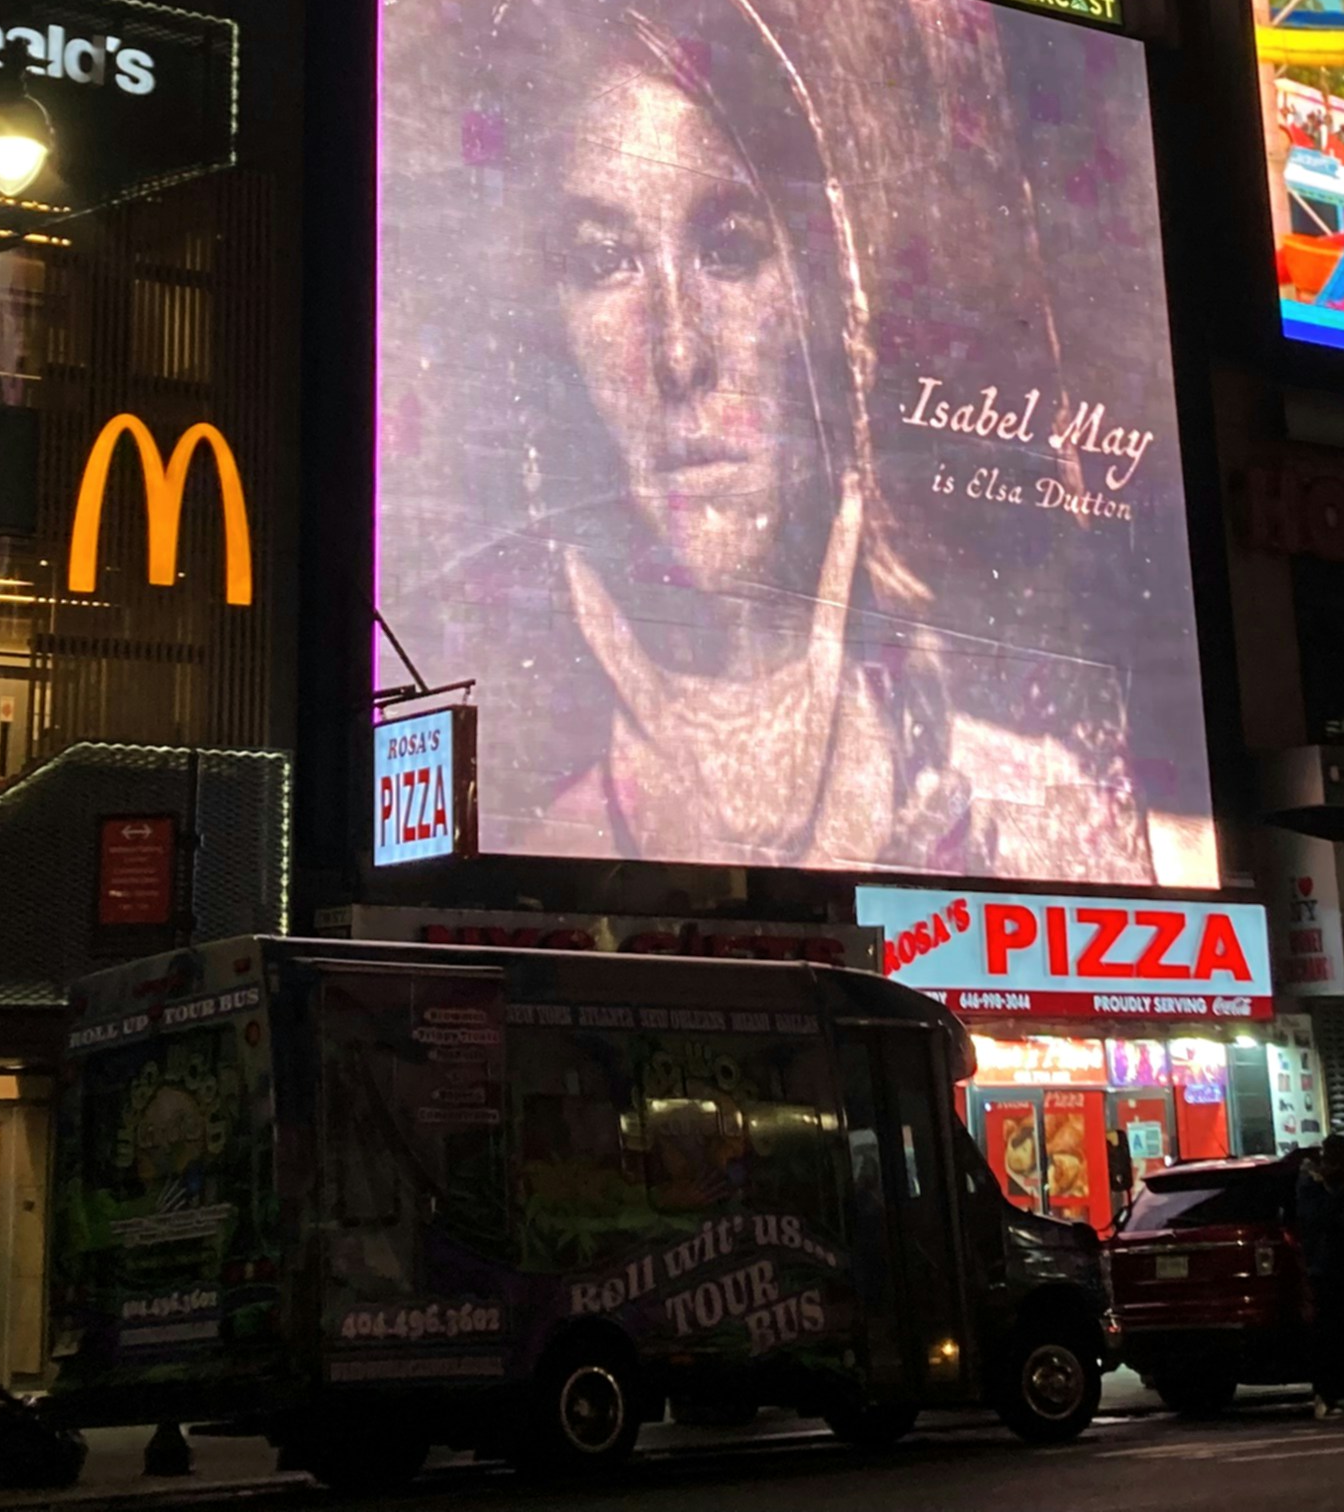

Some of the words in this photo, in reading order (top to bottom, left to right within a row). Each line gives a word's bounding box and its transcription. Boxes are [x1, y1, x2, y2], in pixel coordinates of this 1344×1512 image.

[899, 377, 1040, 442] Isabel
[1048, 401, 1153, 490] May
[932, 464, 954, 494] is
[966, 468, 1023, 504] Elsa
[1036, 478, 1132, 520] Dutton
[388, 729, 440, 759] ROSA'S
[381, 765, 448, 847] PIZZA
[983, 903, 1252, 981] PIZZA
[122, 1015, 148, 1034] UP
[165, 1001, 216, 1025] TOUR
[219, 988, 259, 1010] BUS
[1093, 995, 1151, 1013] PROUDLY
[1154, 996, 1207, 1014] SERVING
[571, 1256, 653, 1316] Roll
[663, 1259, 780, 1335] TOUR
[745, 1290, 825, 1356] BUS
